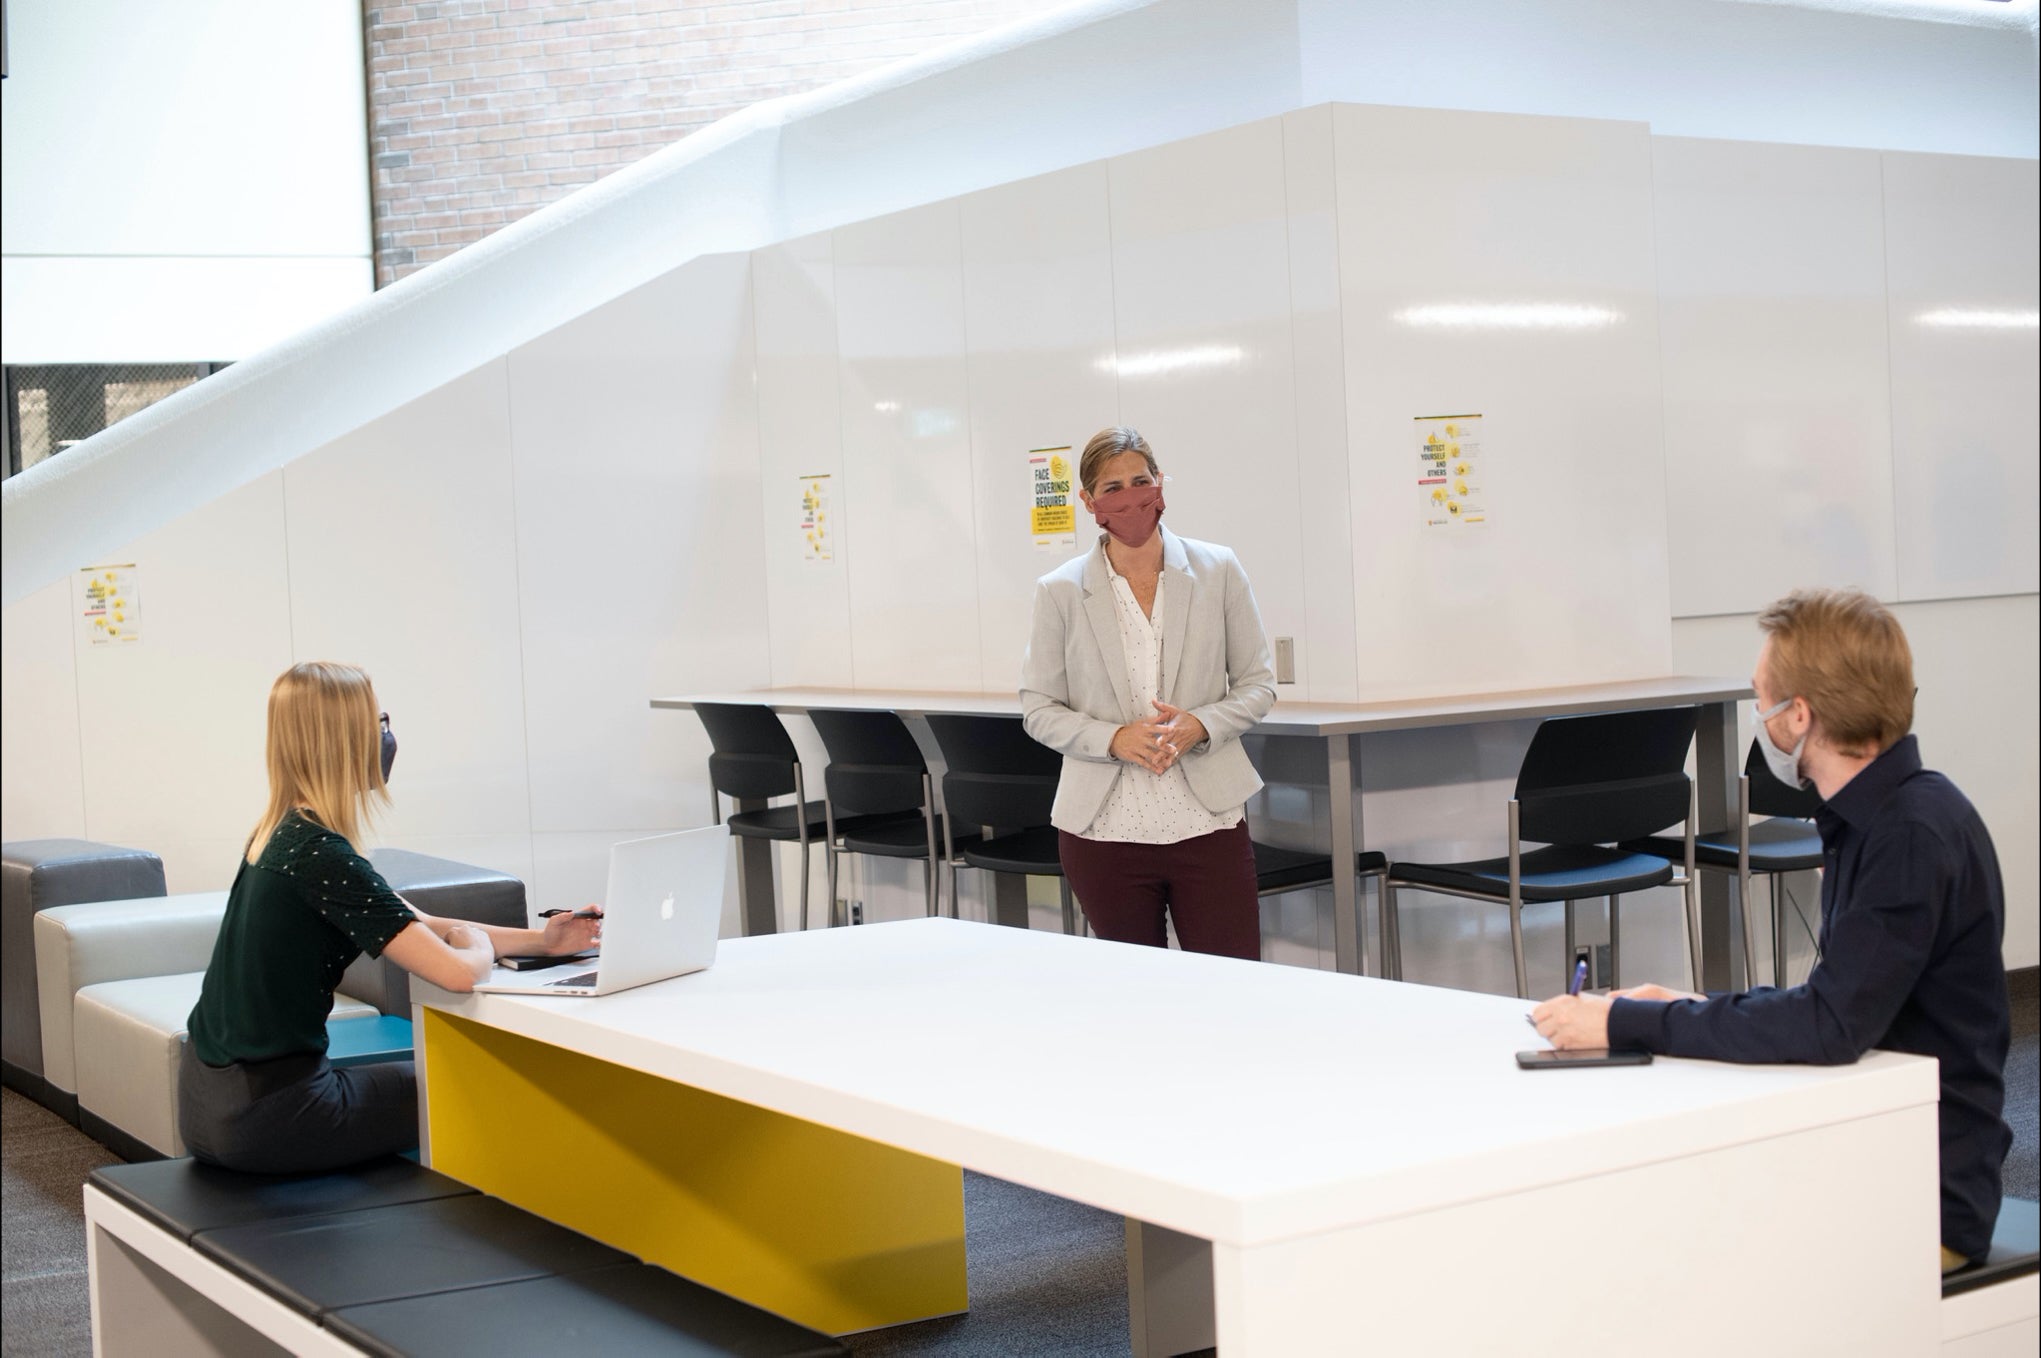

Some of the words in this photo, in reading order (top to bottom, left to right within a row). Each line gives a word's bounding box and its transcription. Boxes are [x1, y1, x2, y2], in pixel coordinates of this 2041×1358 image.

[1423, 444, 1445, 452] PROTECT
[1421, 453, 1446, 461] YOURSELF
[1035, 468, 1049, 480] FACE
[1427, 469, 1447, 477] OTHERS
[1035, 481, 1070, 495] COVERINGS
[1036, 495, 1067, 510] REQUIRED
